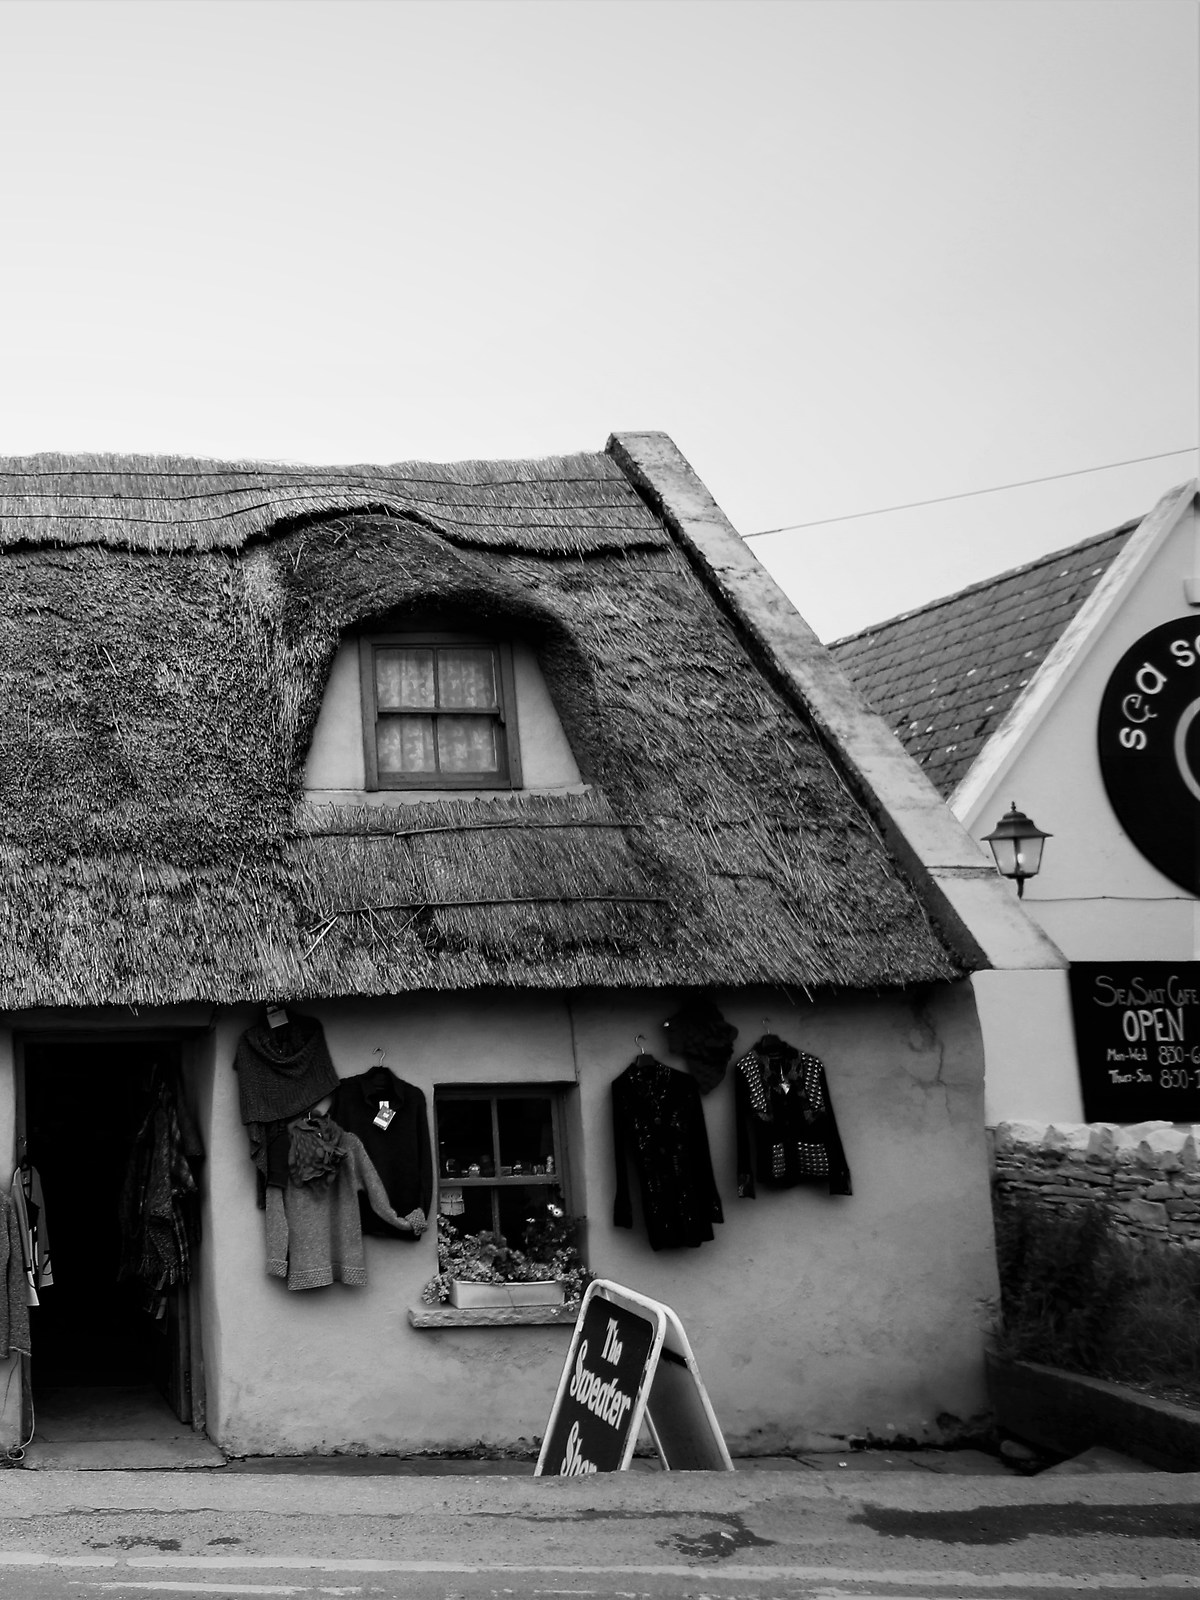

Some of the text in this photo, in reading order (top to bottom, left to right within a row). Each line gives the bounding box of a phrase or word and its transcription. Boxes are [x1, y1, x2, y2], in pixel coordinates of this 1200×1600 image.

[1119, 634, 1200, 750] sea s
[1122, 1007, 1184, 1042] OPEN
[601, 1317, 623, 1366] The
[569, 1339, 631, 1430] Sweater
